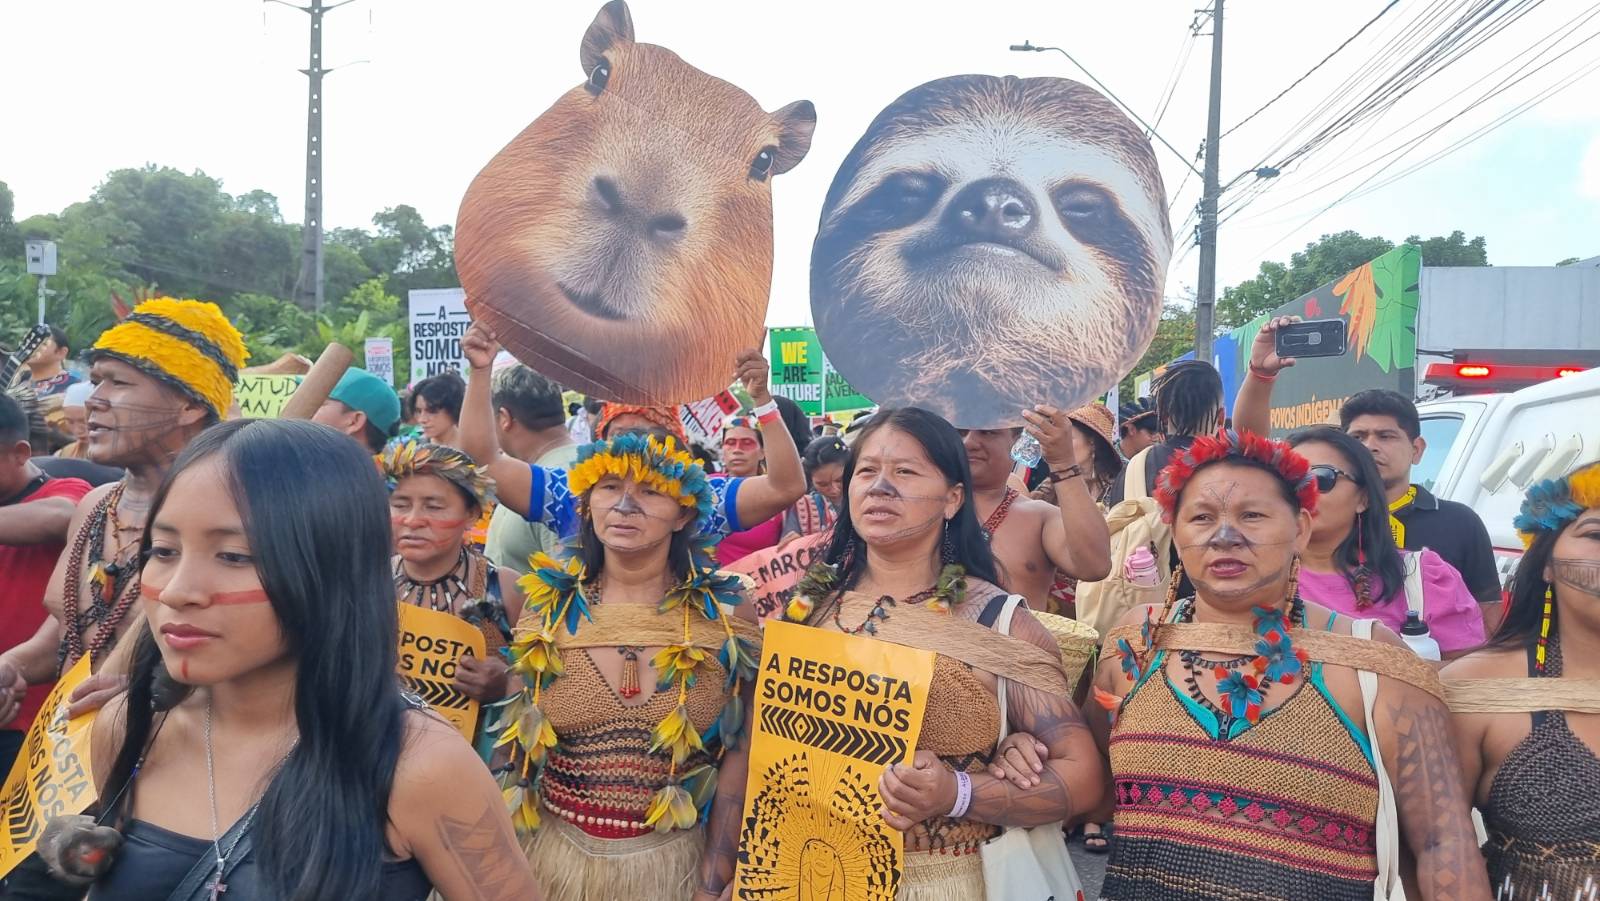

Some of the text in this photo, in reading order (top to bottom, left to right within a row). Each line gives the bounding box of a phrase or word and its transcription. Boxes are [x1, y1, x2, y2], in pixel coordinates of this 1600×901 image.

[438, 305, 446, 320] A
[415, 338, 462, 360] SOMO
[781, 342, 807, 364] WE
[783, 366, 807, 383] ARE
[234, 377, 298, 397] NTUD
[772, 383, 820, 402] NATURE
[236, 398, 270, 416] AN
[401, 631, 475, 657] POSTA
[420, 657, 456, 679] NÓ
[767, 653, 912, 704] A RESPOSTA
[762, 678, 910, 732] SOMOS NÓS
[33, 764, 65, 822] NÓS
